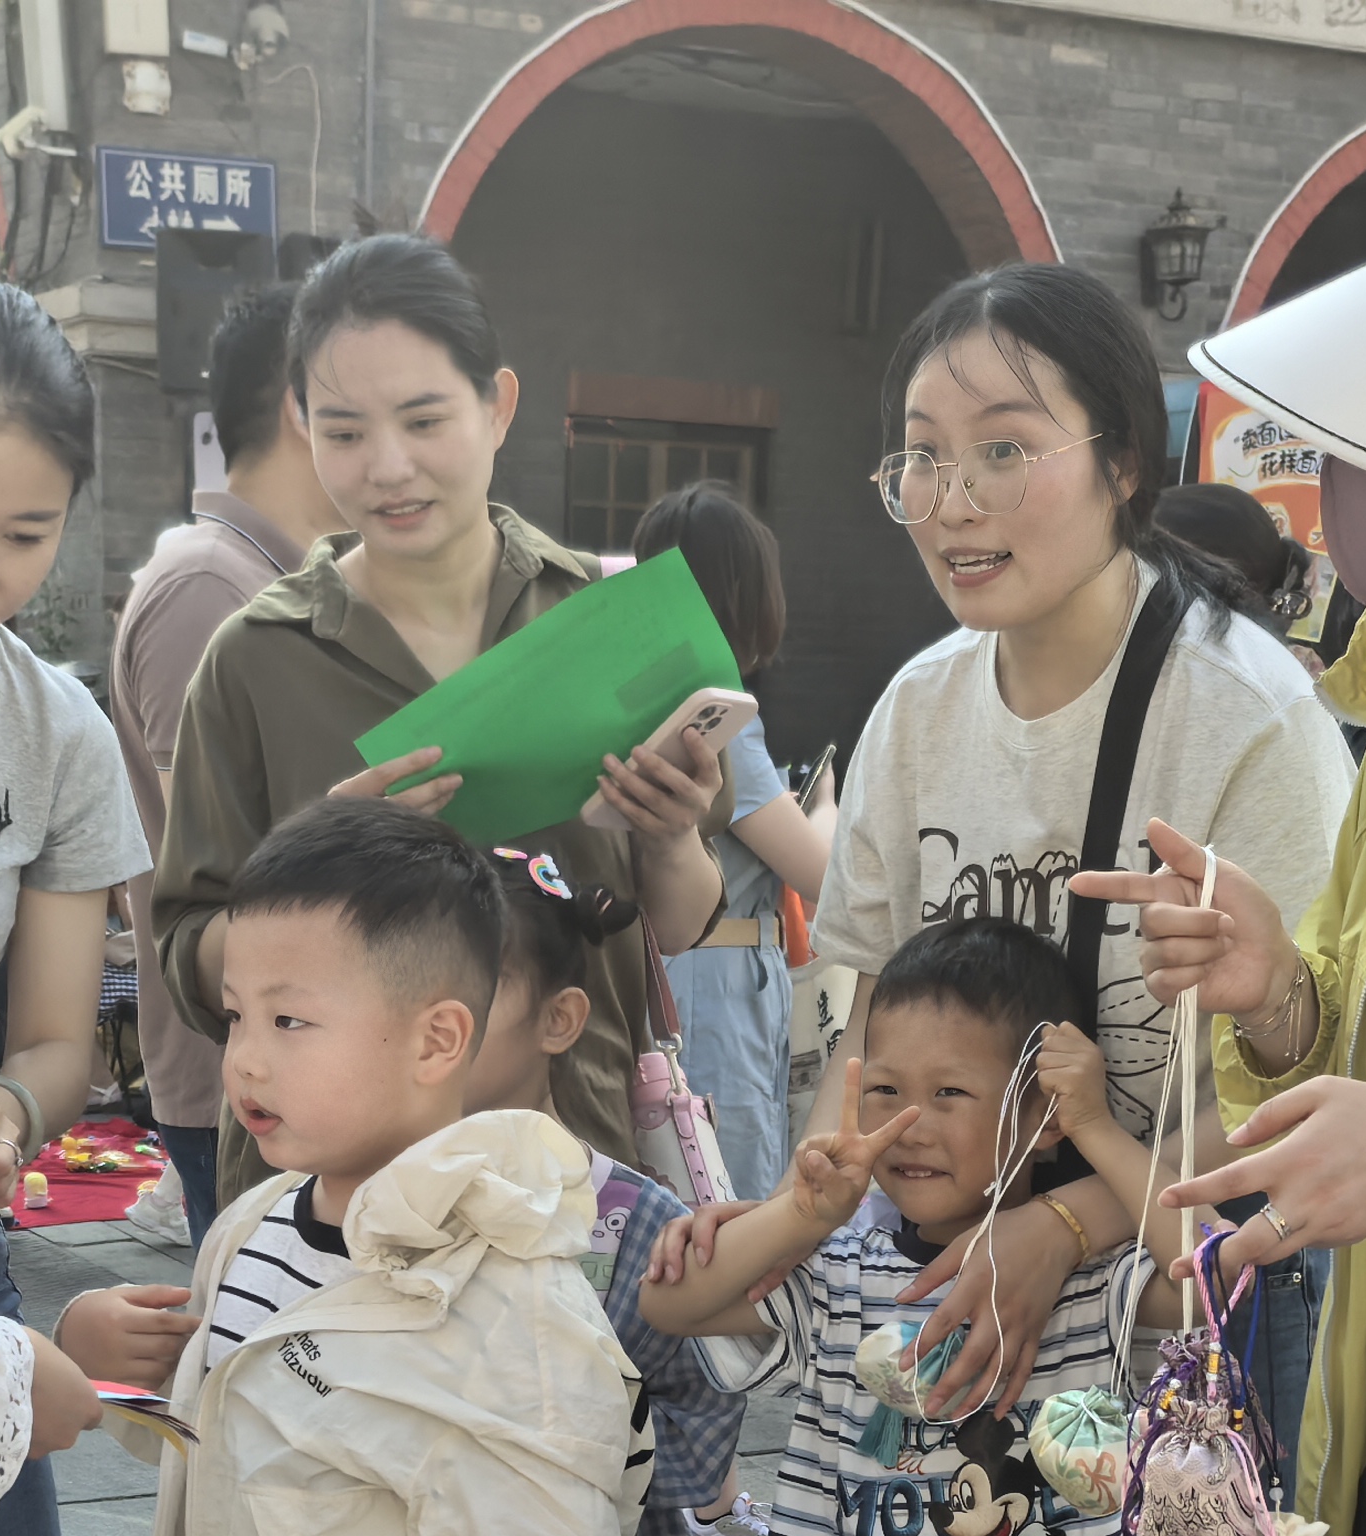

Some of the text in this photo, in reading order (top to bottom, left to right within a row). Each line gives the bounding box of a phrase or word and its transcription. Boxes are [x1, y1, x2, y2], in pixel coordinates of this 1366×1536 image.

[125, 160, 252, 209] 公共厕所
[292, 1331, 322, 1362] hats
